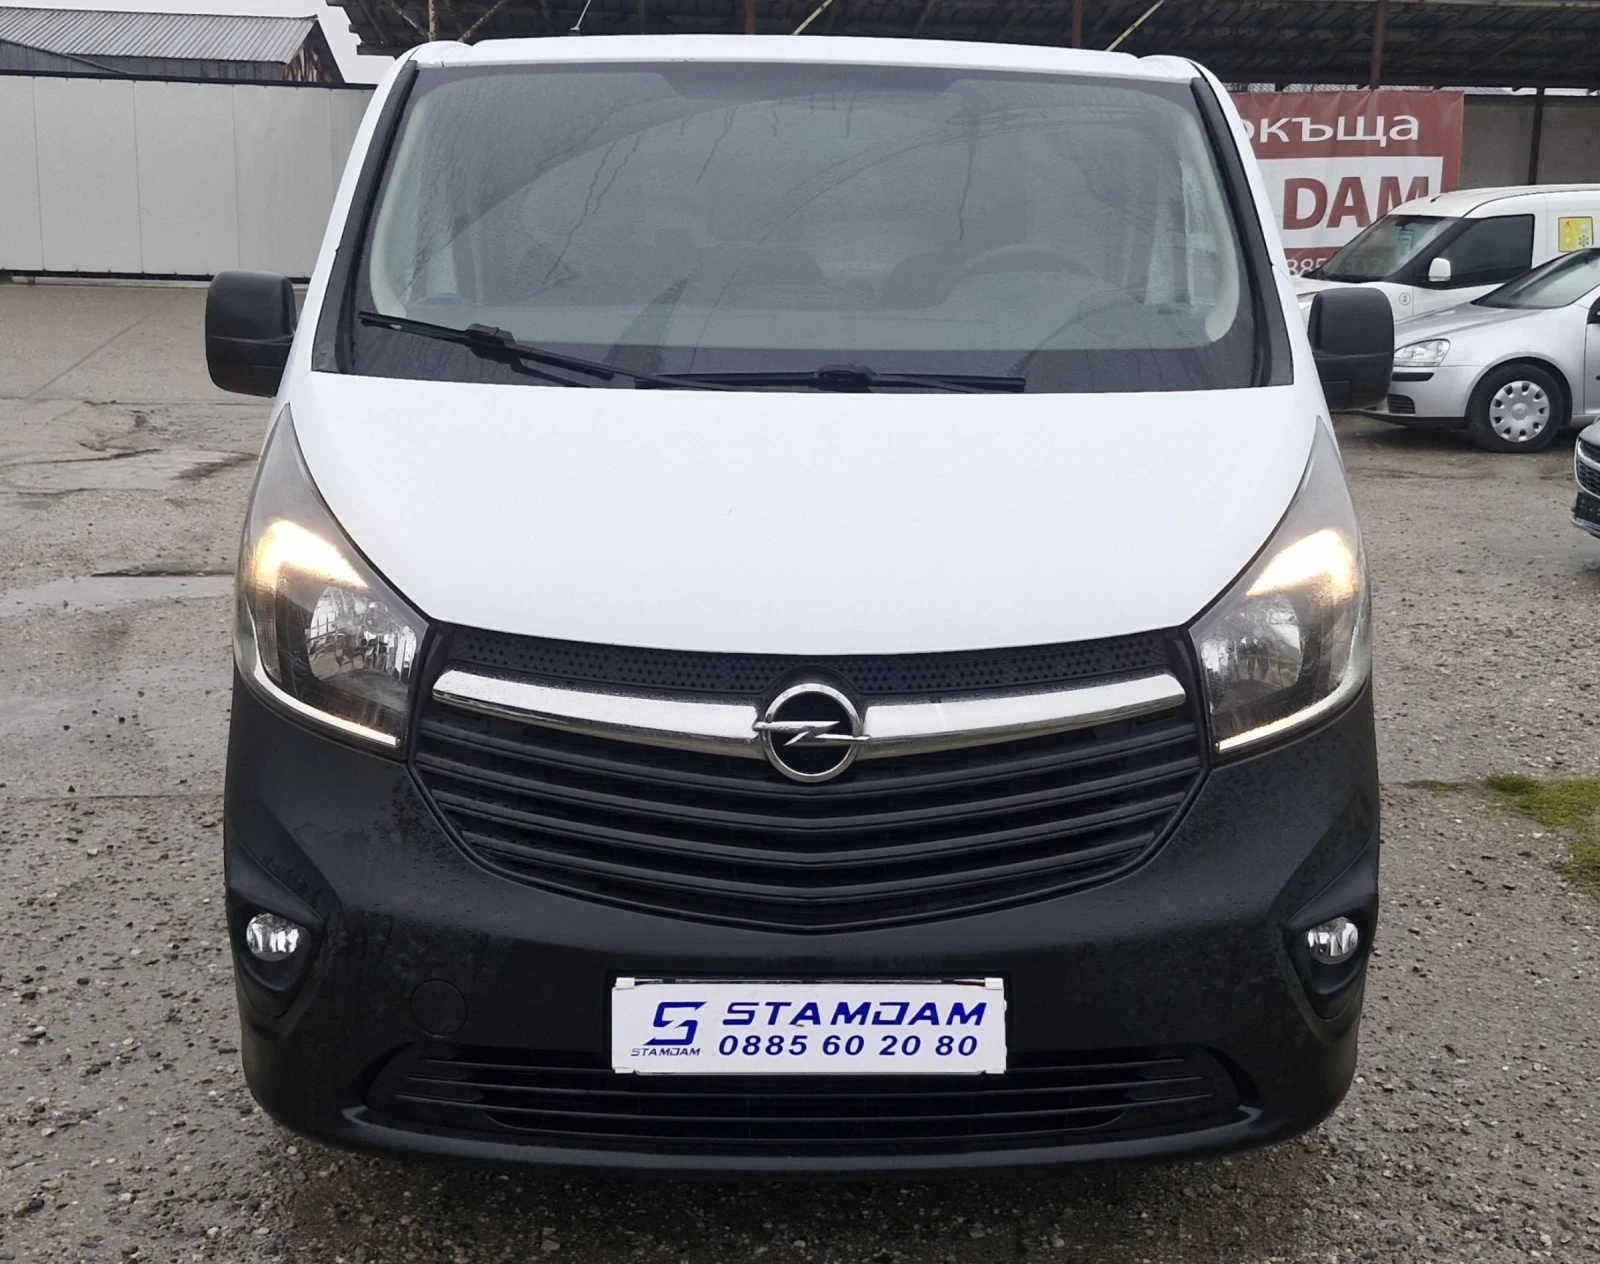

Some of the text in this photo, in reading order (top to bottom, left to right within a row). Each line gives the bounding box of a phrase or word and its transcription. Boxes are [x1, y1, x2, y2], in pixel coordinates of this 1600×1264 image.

[1282, 176, 1429, 230] DAM
[722, 1001, 987, 1026] STAMDAM
[630, 1047, 701, 1057] STAMDAM
[718, 1035, 978, 1056] 0885 60 20 80
